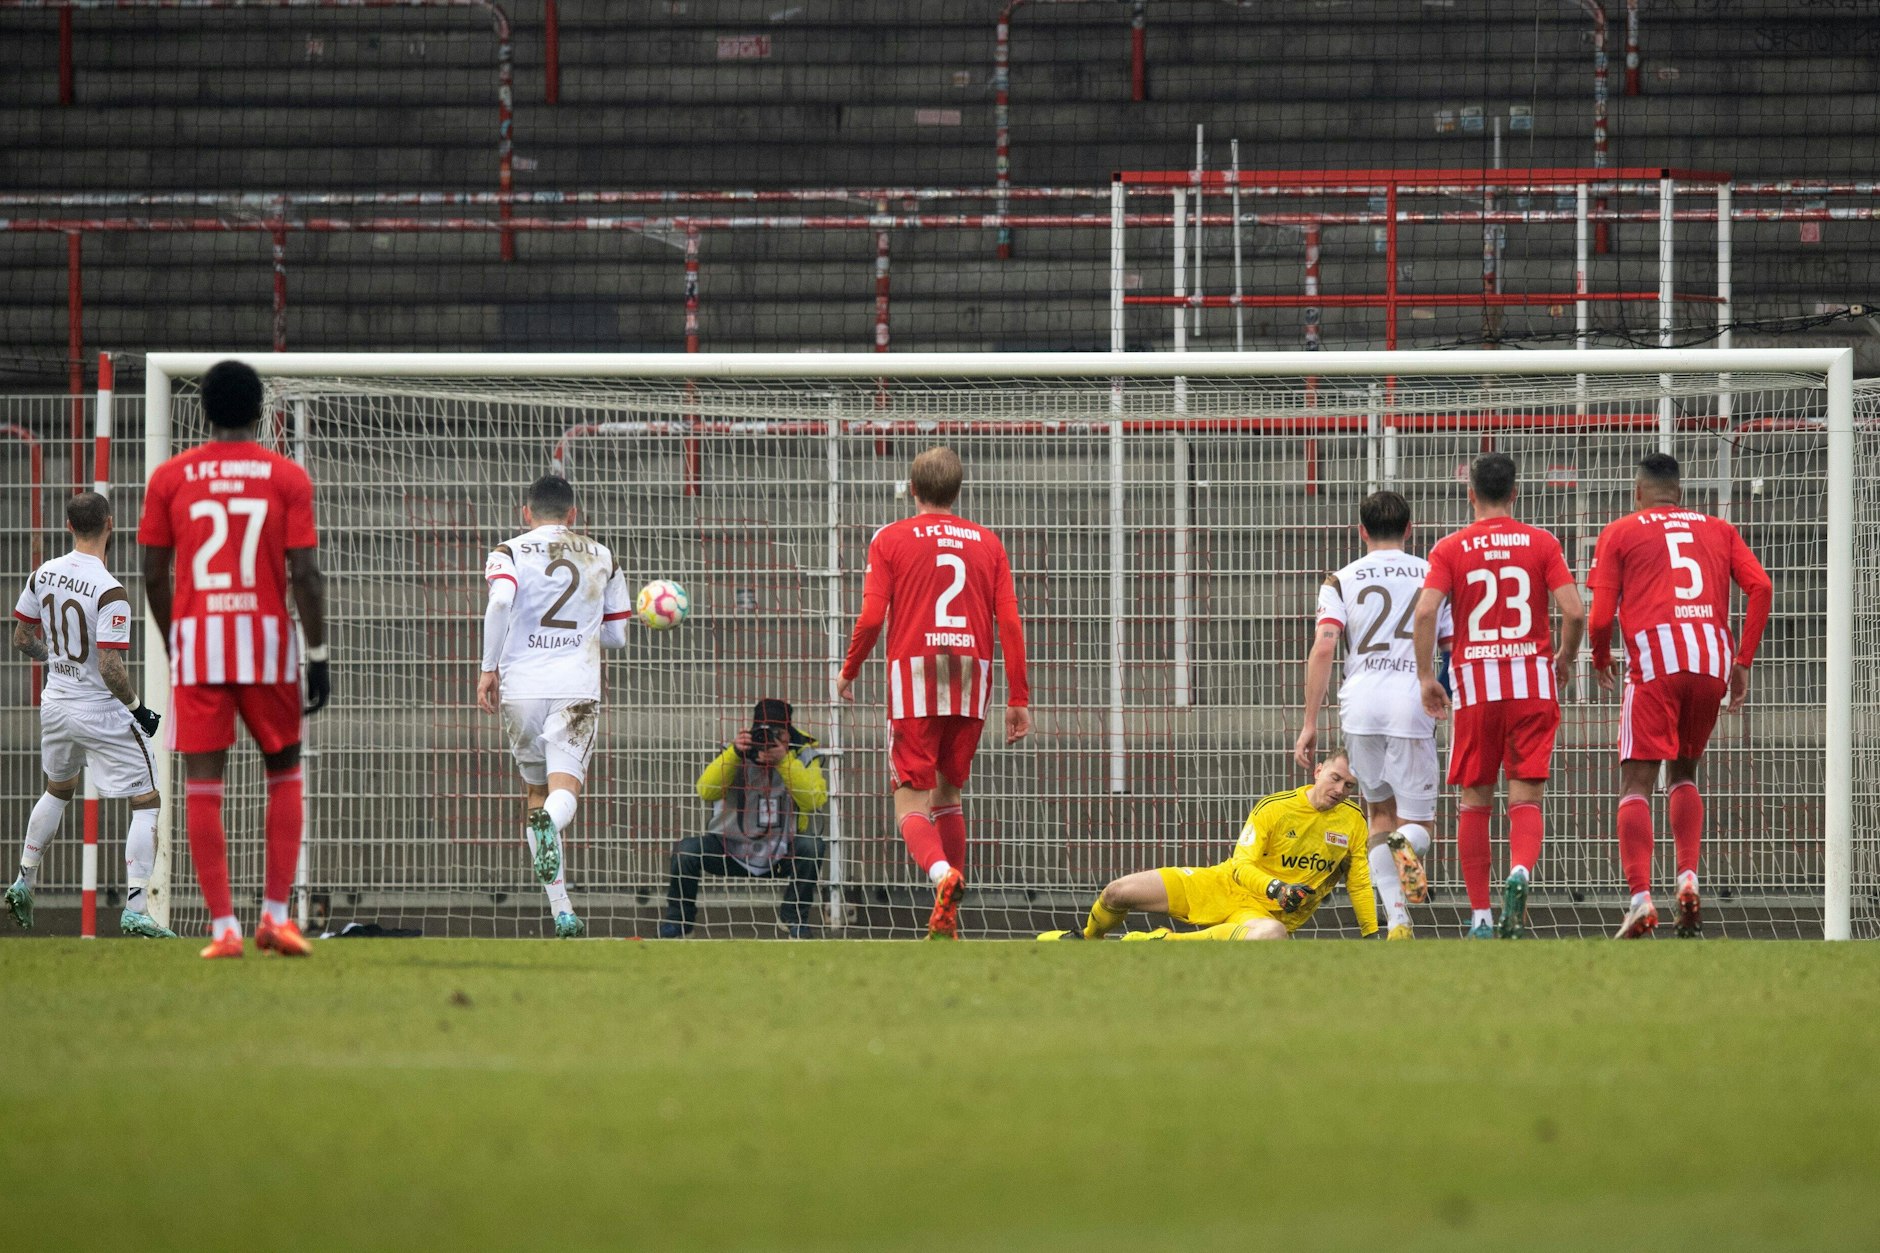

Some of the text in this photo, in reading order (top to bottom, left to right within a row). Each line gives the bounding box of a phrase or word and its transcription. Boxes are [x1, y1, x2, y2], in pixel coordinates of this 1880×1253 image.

[198, 461, 218, 479] FC
[189, 497, 268, 590] 27
[913, 525, 982, 542] 1. FC UNION
[937, 538, 964, 549] BERLIN
[1461, 532, 1531, 553] 1. FC UNION
[521, 541, 599, 557] ST. PAULI
[1484, 550, 1511, 560] BERLIN
[1355, 566, 1429, 581] ST. PAUL
[1665, 532, 1704, 600] 5
[39, 571, 97, 598] ST. PAULI
[540, 558, 580, 630] 2
[935, 553, 967, 628] 2
[1466, 566, 1532, 642] 23
[1674, 604, 1713, 618] DOEKHI
[42, 593, 90, 664] 10
[1356, 585, 1423, 655] 24
[925, 633, 975, 648] THORSBY
[1281, 853, 1335, 873] wefox
